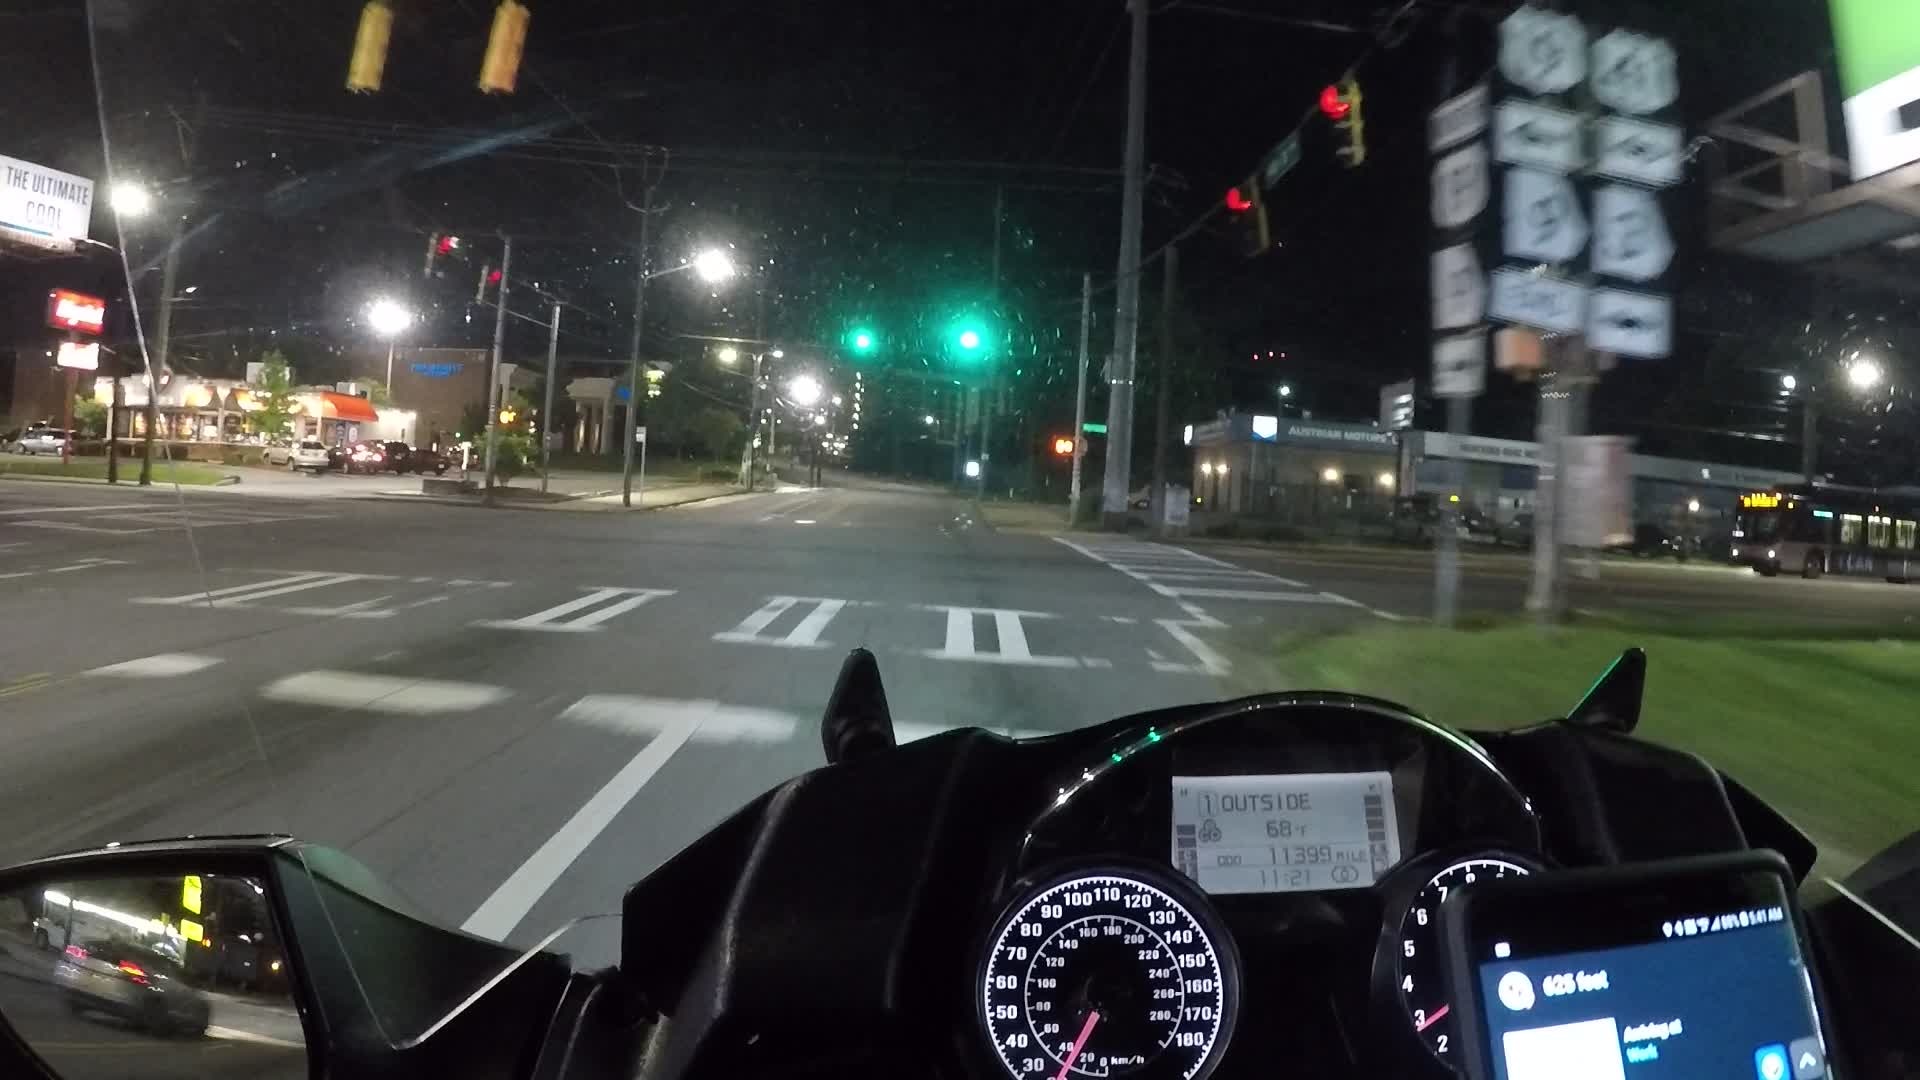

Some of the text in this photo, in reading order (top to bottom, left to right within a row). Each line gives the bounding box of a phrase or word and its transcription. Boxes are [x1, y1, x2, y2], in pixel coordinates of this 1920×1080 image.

[7, 166, 89, 206] THE ULTIMATE
[1221, 792, 1312, 813] OUTSIDE
[1063, 892, 1093, 906] 100
[1093, 887, 1121, 902] 110
[1123, 894, 1152, 909] 120
[1438, 886, 1448, 903] 7
[1041, 904, 1063, 919] 90
[1148, 910, 1176, 925] 130
[1416, 908, 1427, 926] 6
[1020, 922, 1042, 937] 80
[1163, 929, 1193, 945] 140
[1058, 939, 1079, 950] 140
[1123, 934, 1145, 945] 200
[1006, 946, 1027, 961] 70
[1138, 949, 1160, 960] 220
[1404, 940, 1415, 958] 5
[1045, 956, 1065, 967] 120
[1178, 952, 1206, 968] 150
[1148, 968, 1170, 979] 240
[996, 974, 1018, 990] 60
[1037, 978, 1057, 989] 100
[1184, 978, 1213, 994] 160
[1402, 975, 1414, 993] 4
[1153, 988, 1175, 999] 260
[996, 1004, 1018, 1020] 50
[1184, 1006, 1212, 1021] 170
[1414, 1009, 1426, 1027] 3
[1043, 1023, 1060, 1034] 60
[1005, 1033, 1028, 1049] 40
[1058, 1041, 1075, 1052] 40
[1175, 1031, 1204, 1047] 180
[1437, 1034, 1448, 1053] 2
[1022, 1057, 1045, 1072] 30
[1079, 1052, 1095, 1063] 20
[1099, 1055, 1145, 1067] 0 km/h
